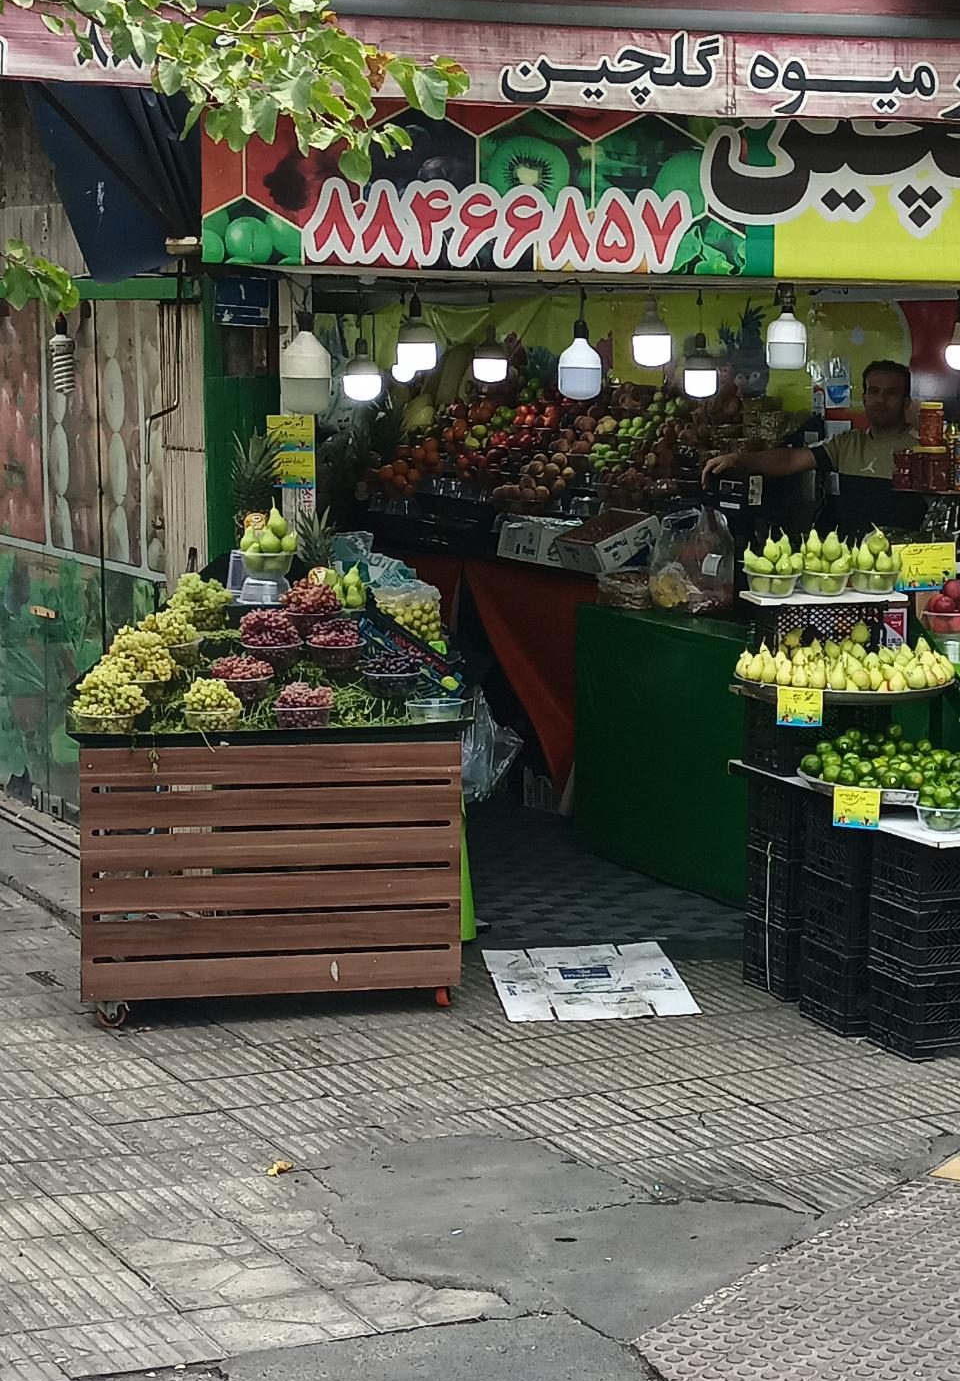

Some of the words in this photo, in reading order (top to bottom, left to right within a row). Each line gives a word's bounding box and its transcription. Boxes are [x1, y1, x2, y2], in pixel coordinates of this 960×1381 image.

[499, 31, 723, 104] گلچین
[748, 52, 937, 116] میوه
[309, 183, 688, 269] ۸۸۴۶۶۸۵۷
